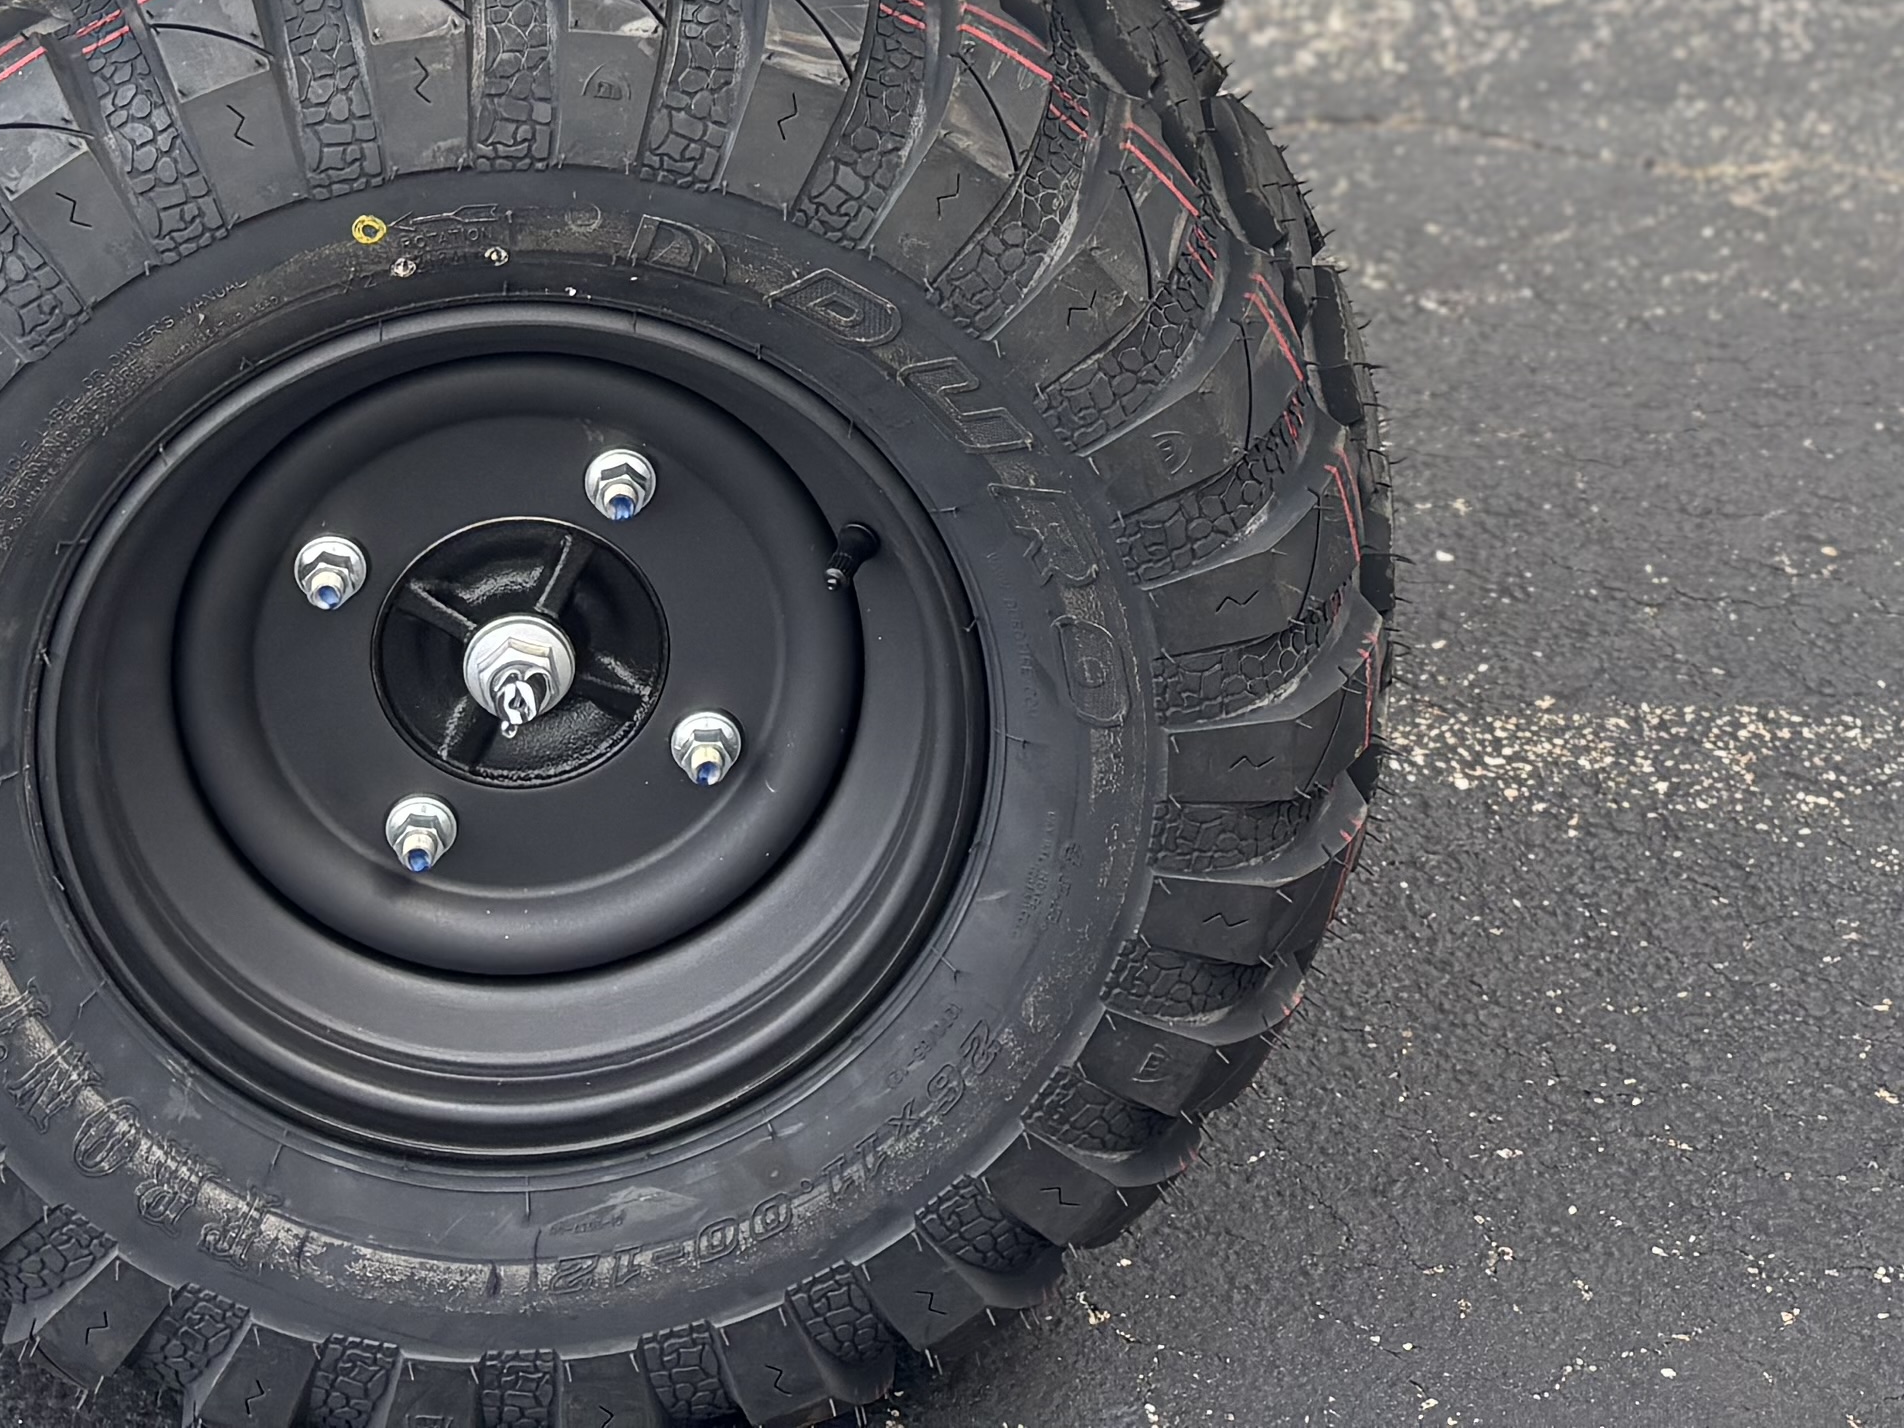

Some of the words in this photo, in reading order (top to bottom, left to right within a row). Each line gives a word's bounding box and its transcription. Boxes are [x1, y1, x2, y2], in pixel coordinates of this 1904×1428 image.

[397, 224, 493, 250] ROTATION
[105, 313, 179, 368] OWNER'S
[178, 274, 250, 317] MANUAL
[1, 426, 72, 511] OPERATING
[66, 356, 146, 427] PRESSURE
[766, 268, 1133, 728] DURO
[551, 1016, 1010, 1296] 26x11.00-12
